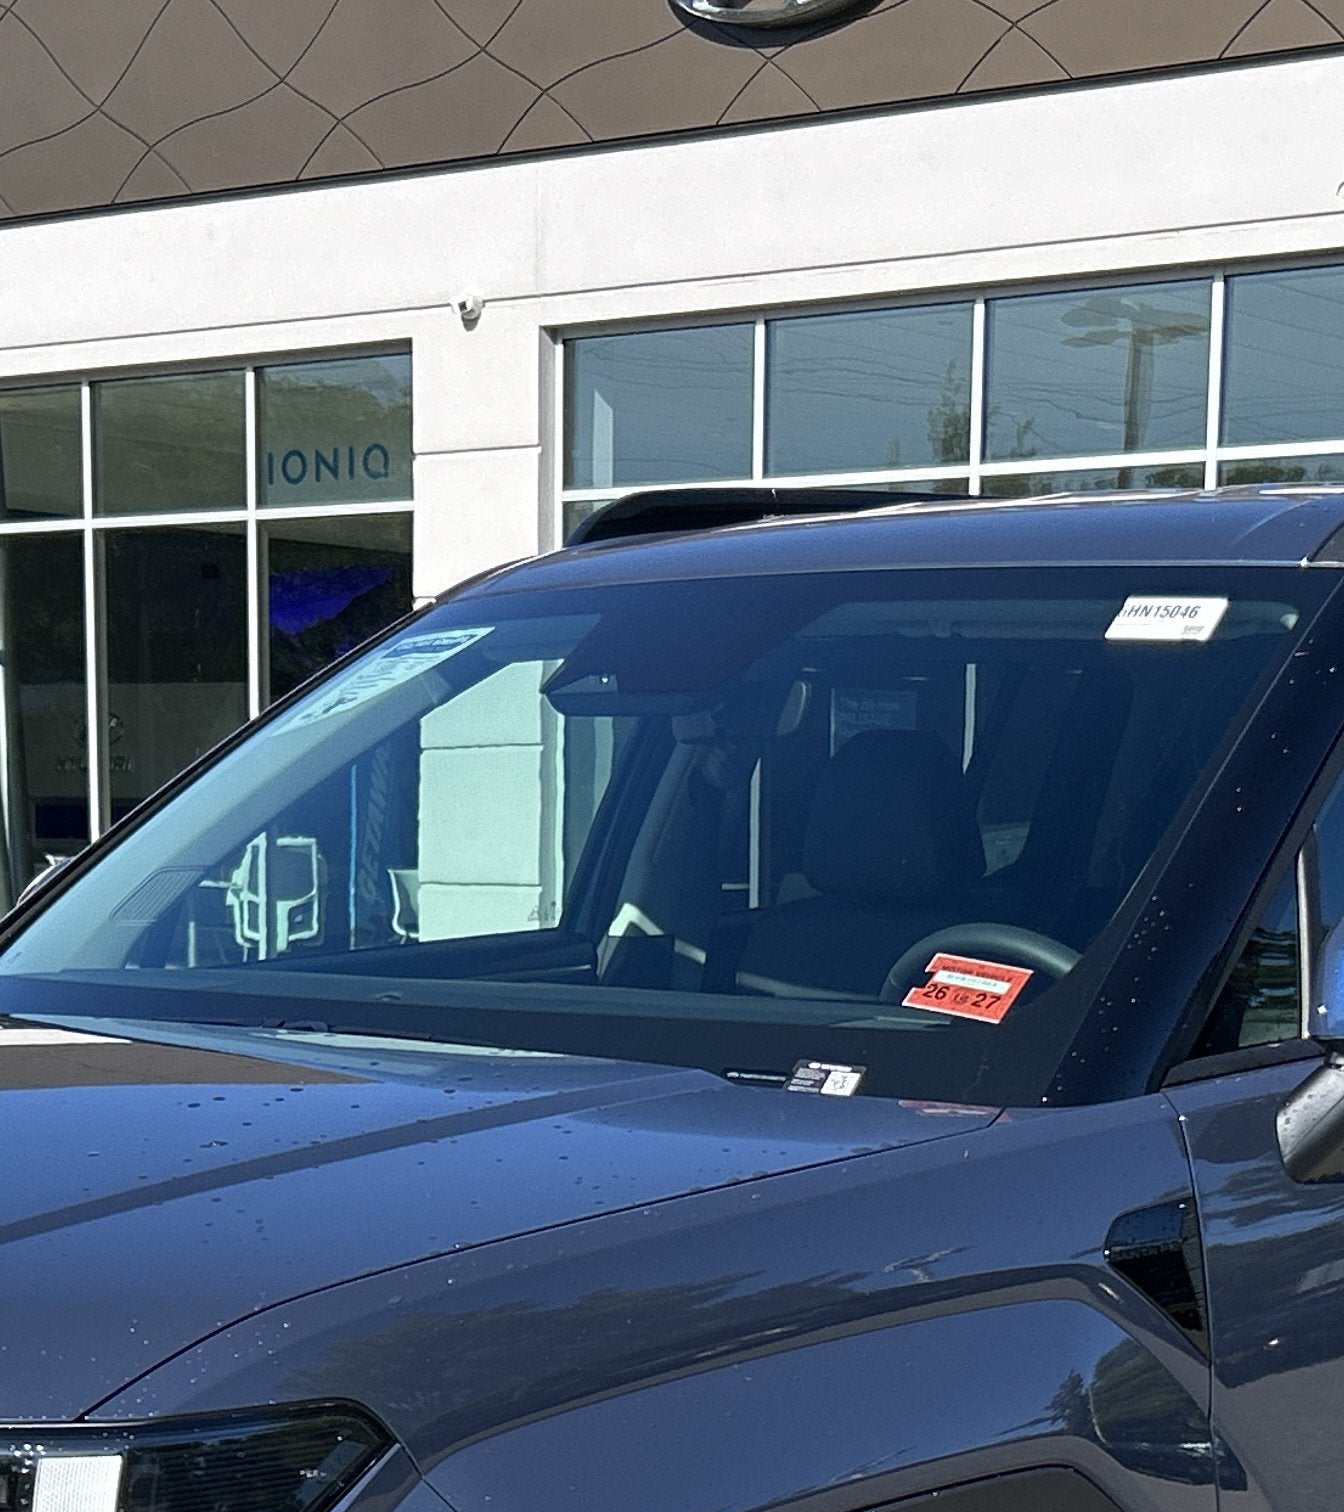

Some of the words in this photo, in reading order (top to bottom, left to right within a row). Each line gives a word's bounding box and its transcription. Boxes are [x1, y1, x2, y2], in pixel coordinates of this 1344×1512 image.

[267, 443, 389, 486] IONIQ
[922, 983, 950, 1000] 26
[970, 993, 1001, 1009] 27
